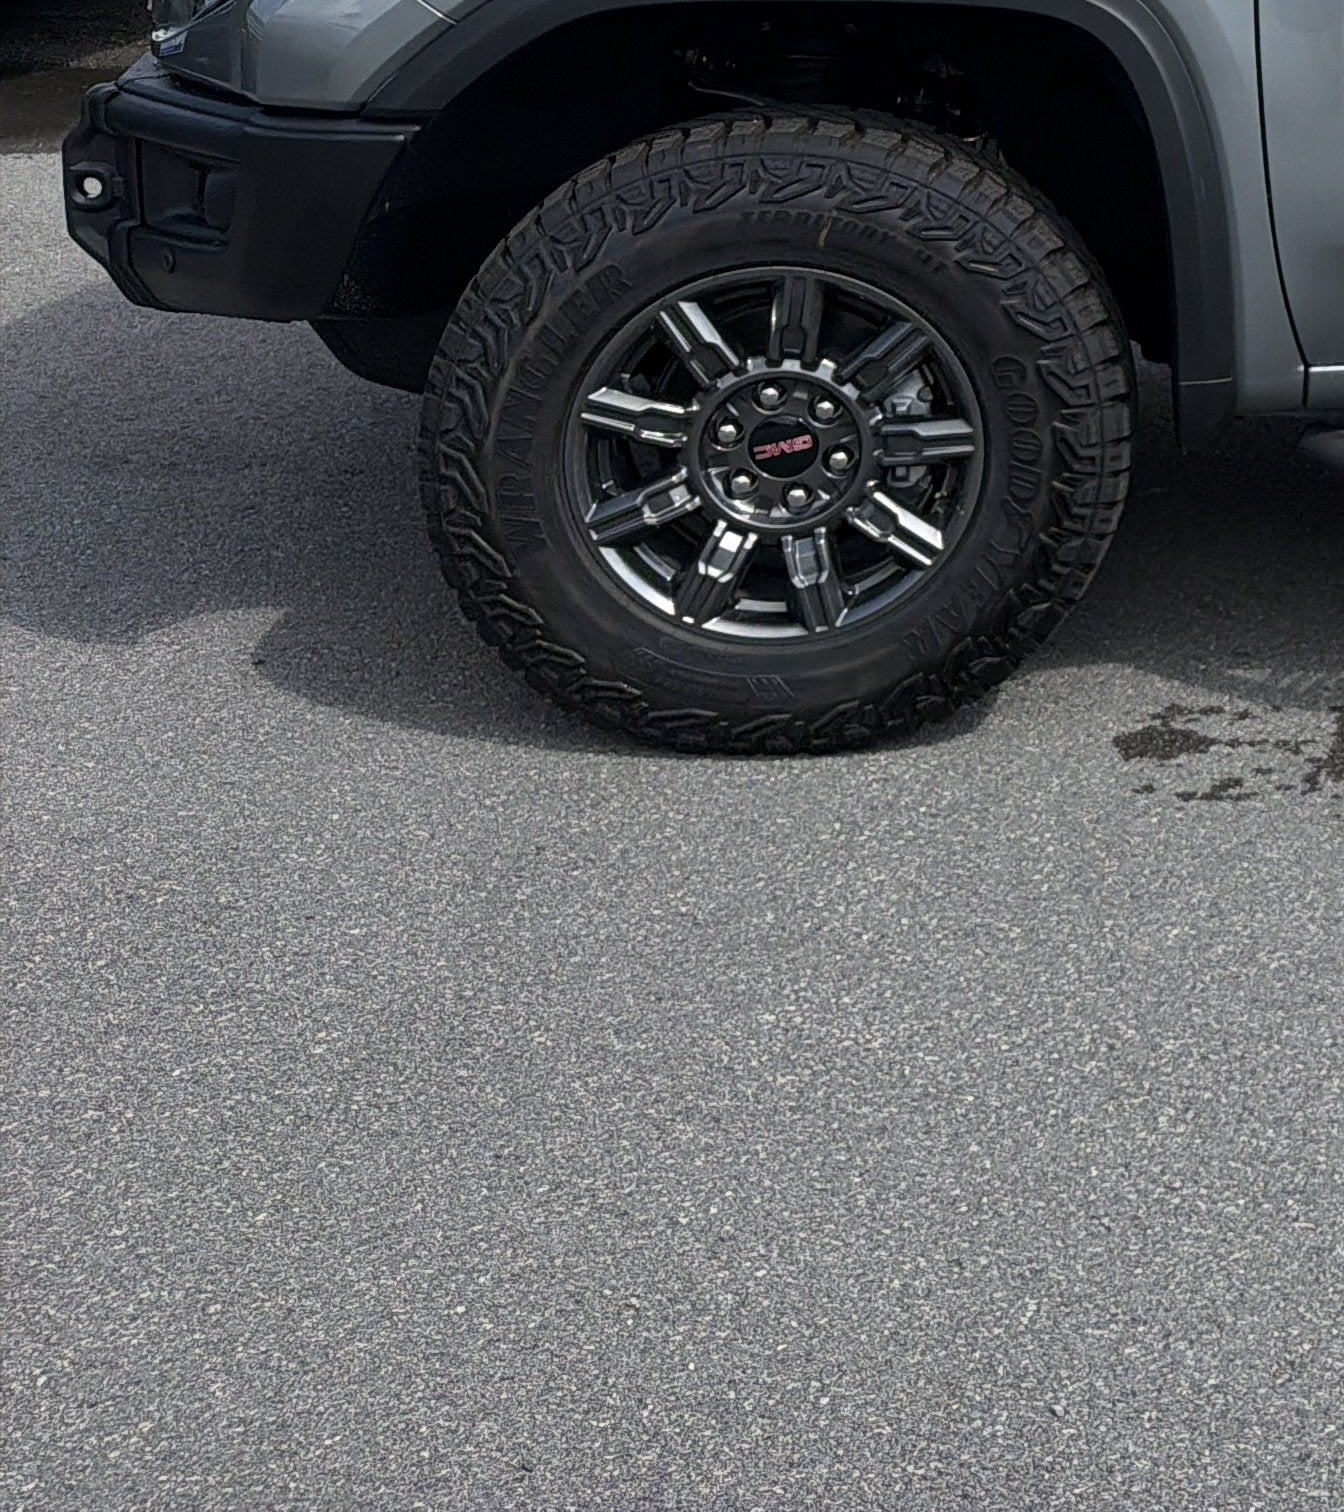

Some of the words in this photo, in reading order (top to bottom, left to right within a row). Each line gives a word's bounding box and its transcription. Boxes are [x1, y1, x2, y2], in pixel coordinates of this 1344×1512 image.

[498, 263, 634, 550] WRANGLER
[752, 434, 814, 461] GMC
[900, 355, 1044, 662] GOODYEAR
